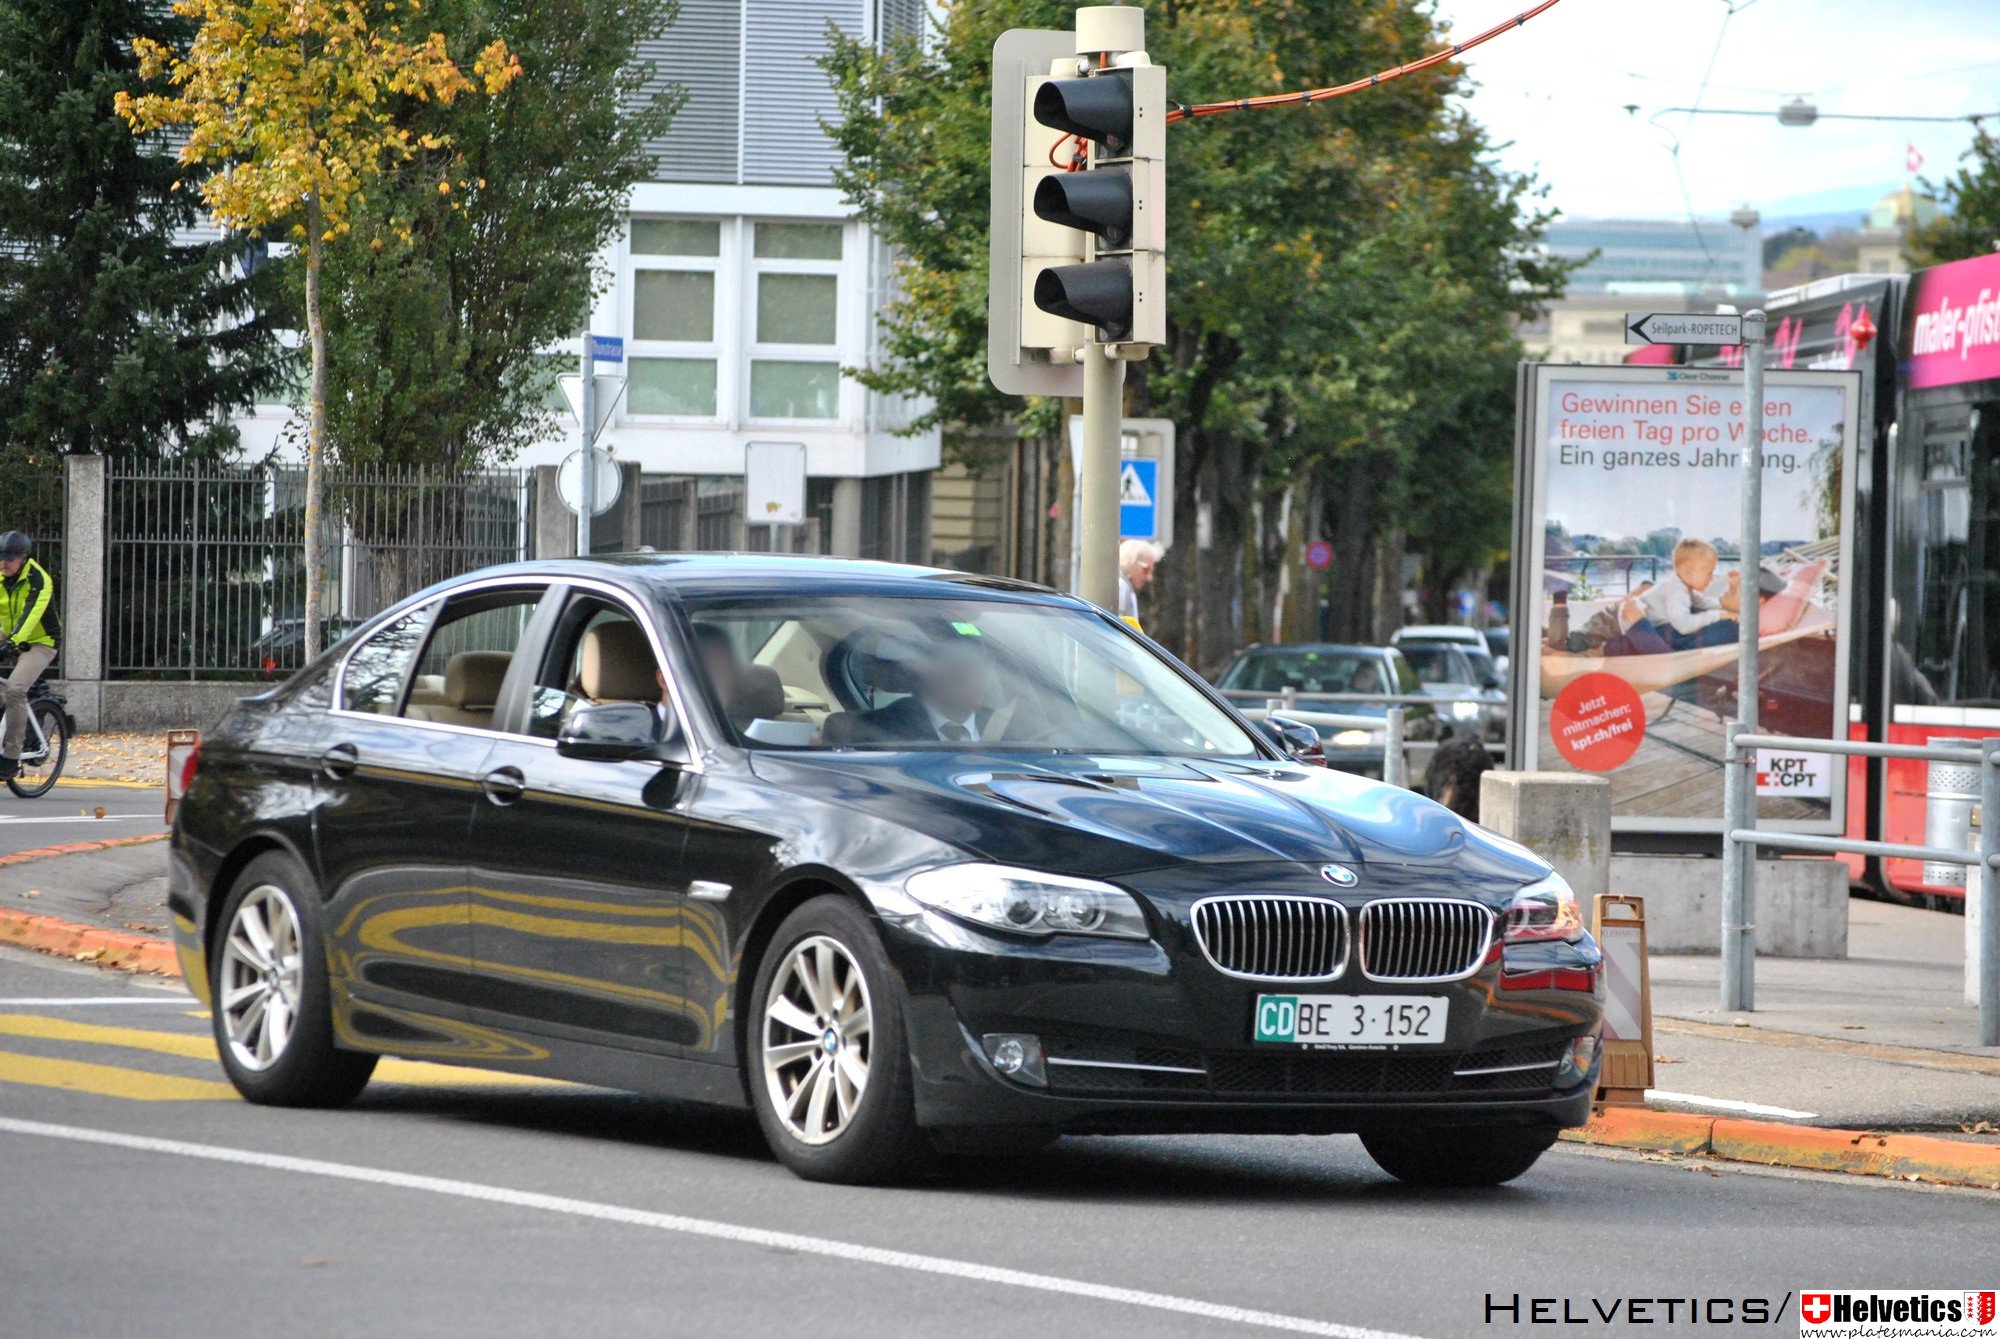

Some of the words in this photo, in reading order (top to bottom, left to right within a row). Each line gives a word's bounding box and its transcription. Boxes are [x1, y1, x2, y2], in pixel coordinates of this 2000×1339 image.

[1651, 322, 1738, 336] Seilpark-ROPETECH
[1561, 392, 1678, 414] Gewinnen
[1686, 394, 1721, 416] Sie
[1729, 400, 1792, 417] een
[1560, 418, 1625, 440] freien
[1633, 420, 1673, 446] Tag
[1682, 426, 1720, 446] pro
[1560, 444, 1594, 465] Ein
[1603, 450, 1681, 471] ganzes
[1688, 447, 1740, 468] Jahr
[1578, 695, 1607, 715] Jetzt
[1562, 704, 1632, 737] mitmachen:
[1570, 718, 1633, 751] kpt.ch/frei
[1770, 758, 1807, 772] KPT
[1780, 773, 1817, 787] CPT
[1260, 1002, 1294, 1036] CD
[1298, 1004, 1332, 1036] BE
